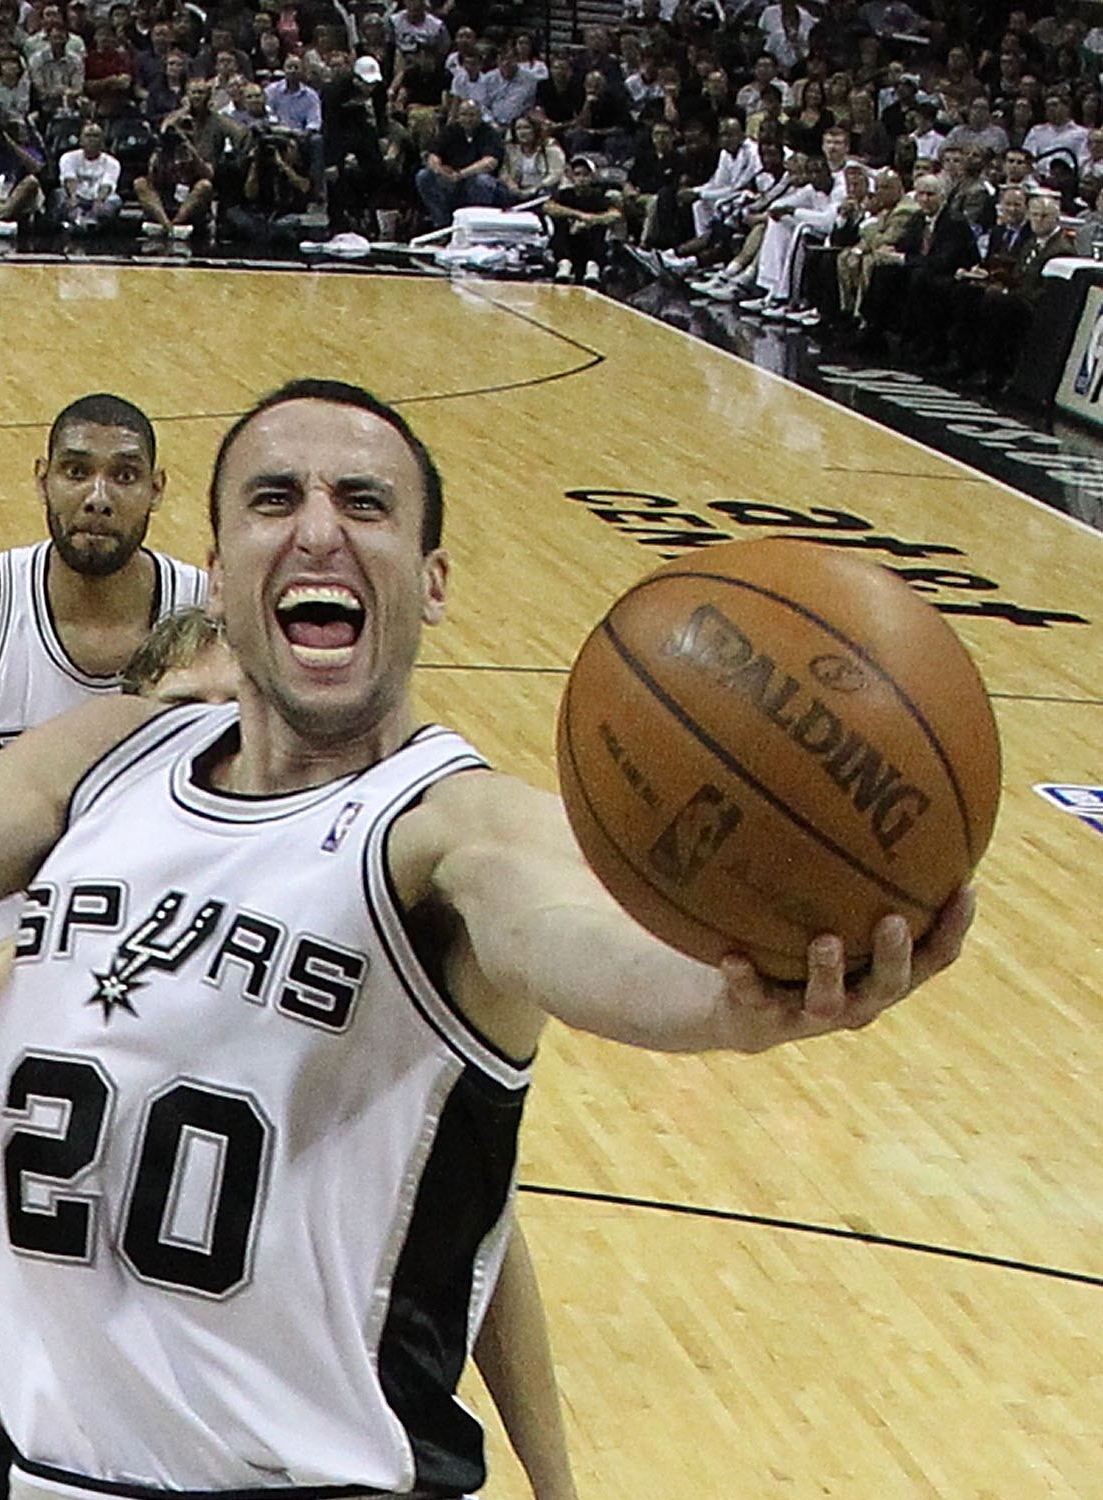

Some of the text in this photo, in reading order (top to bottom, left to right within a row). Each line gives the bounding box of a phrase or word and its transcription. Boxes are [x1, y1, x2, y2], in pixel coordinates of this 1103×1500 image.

[563, 488, 735, 559] CEN
[13, 876, 371, 1035] SPURS
[1, 1046, 276, 1302] 20
